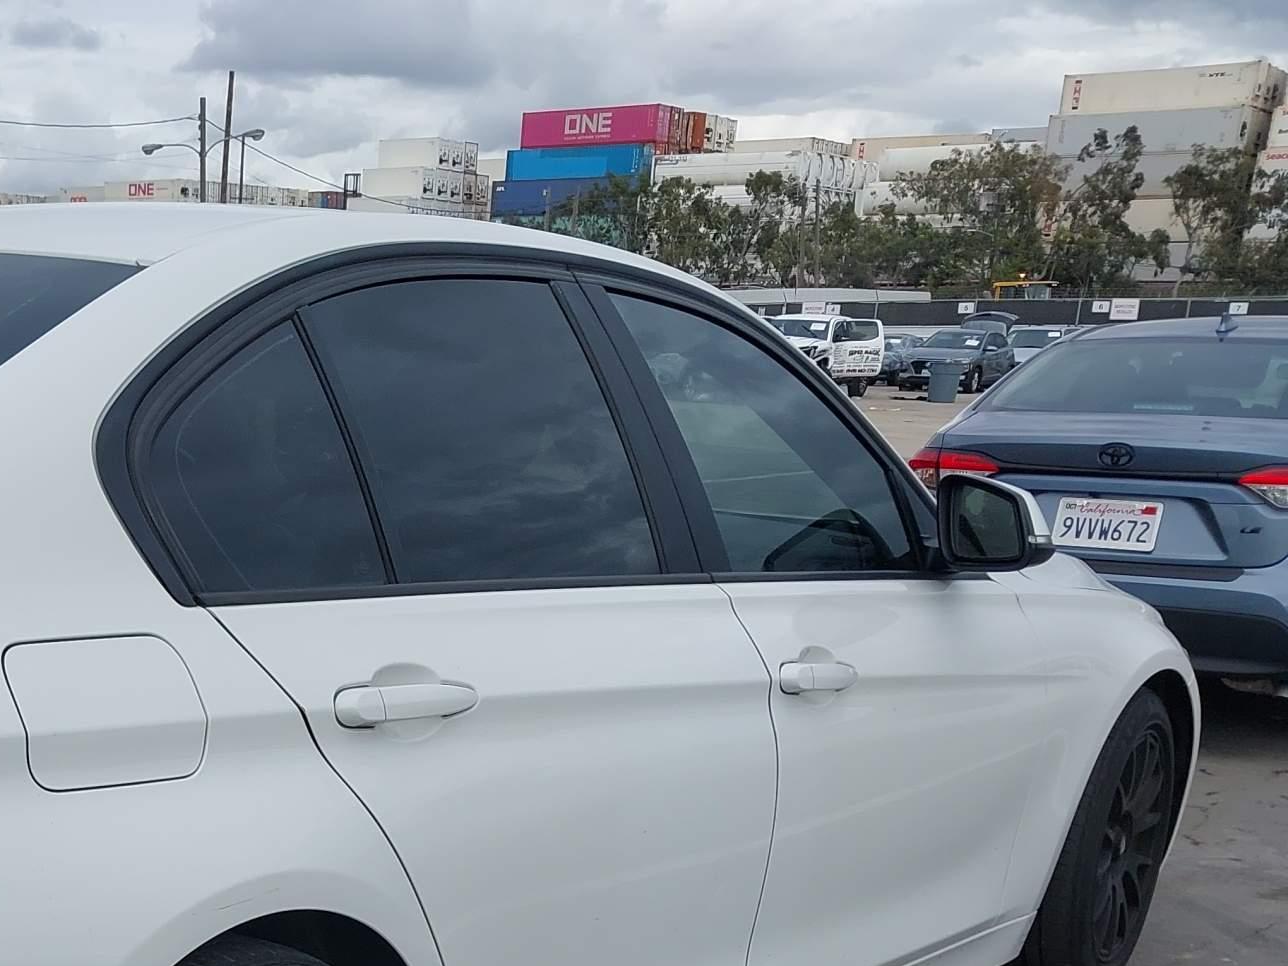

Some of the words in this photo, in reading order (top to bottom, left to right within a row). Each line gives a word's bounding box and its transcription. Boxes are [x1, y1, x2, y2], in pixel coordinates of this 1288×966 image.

[564, 112, 612, 134] ONE
[128, 183, 154, 196] ONE
[1079, 502, 1135, 517] California
[1058, 516, 1151, 543] 9VVW672
